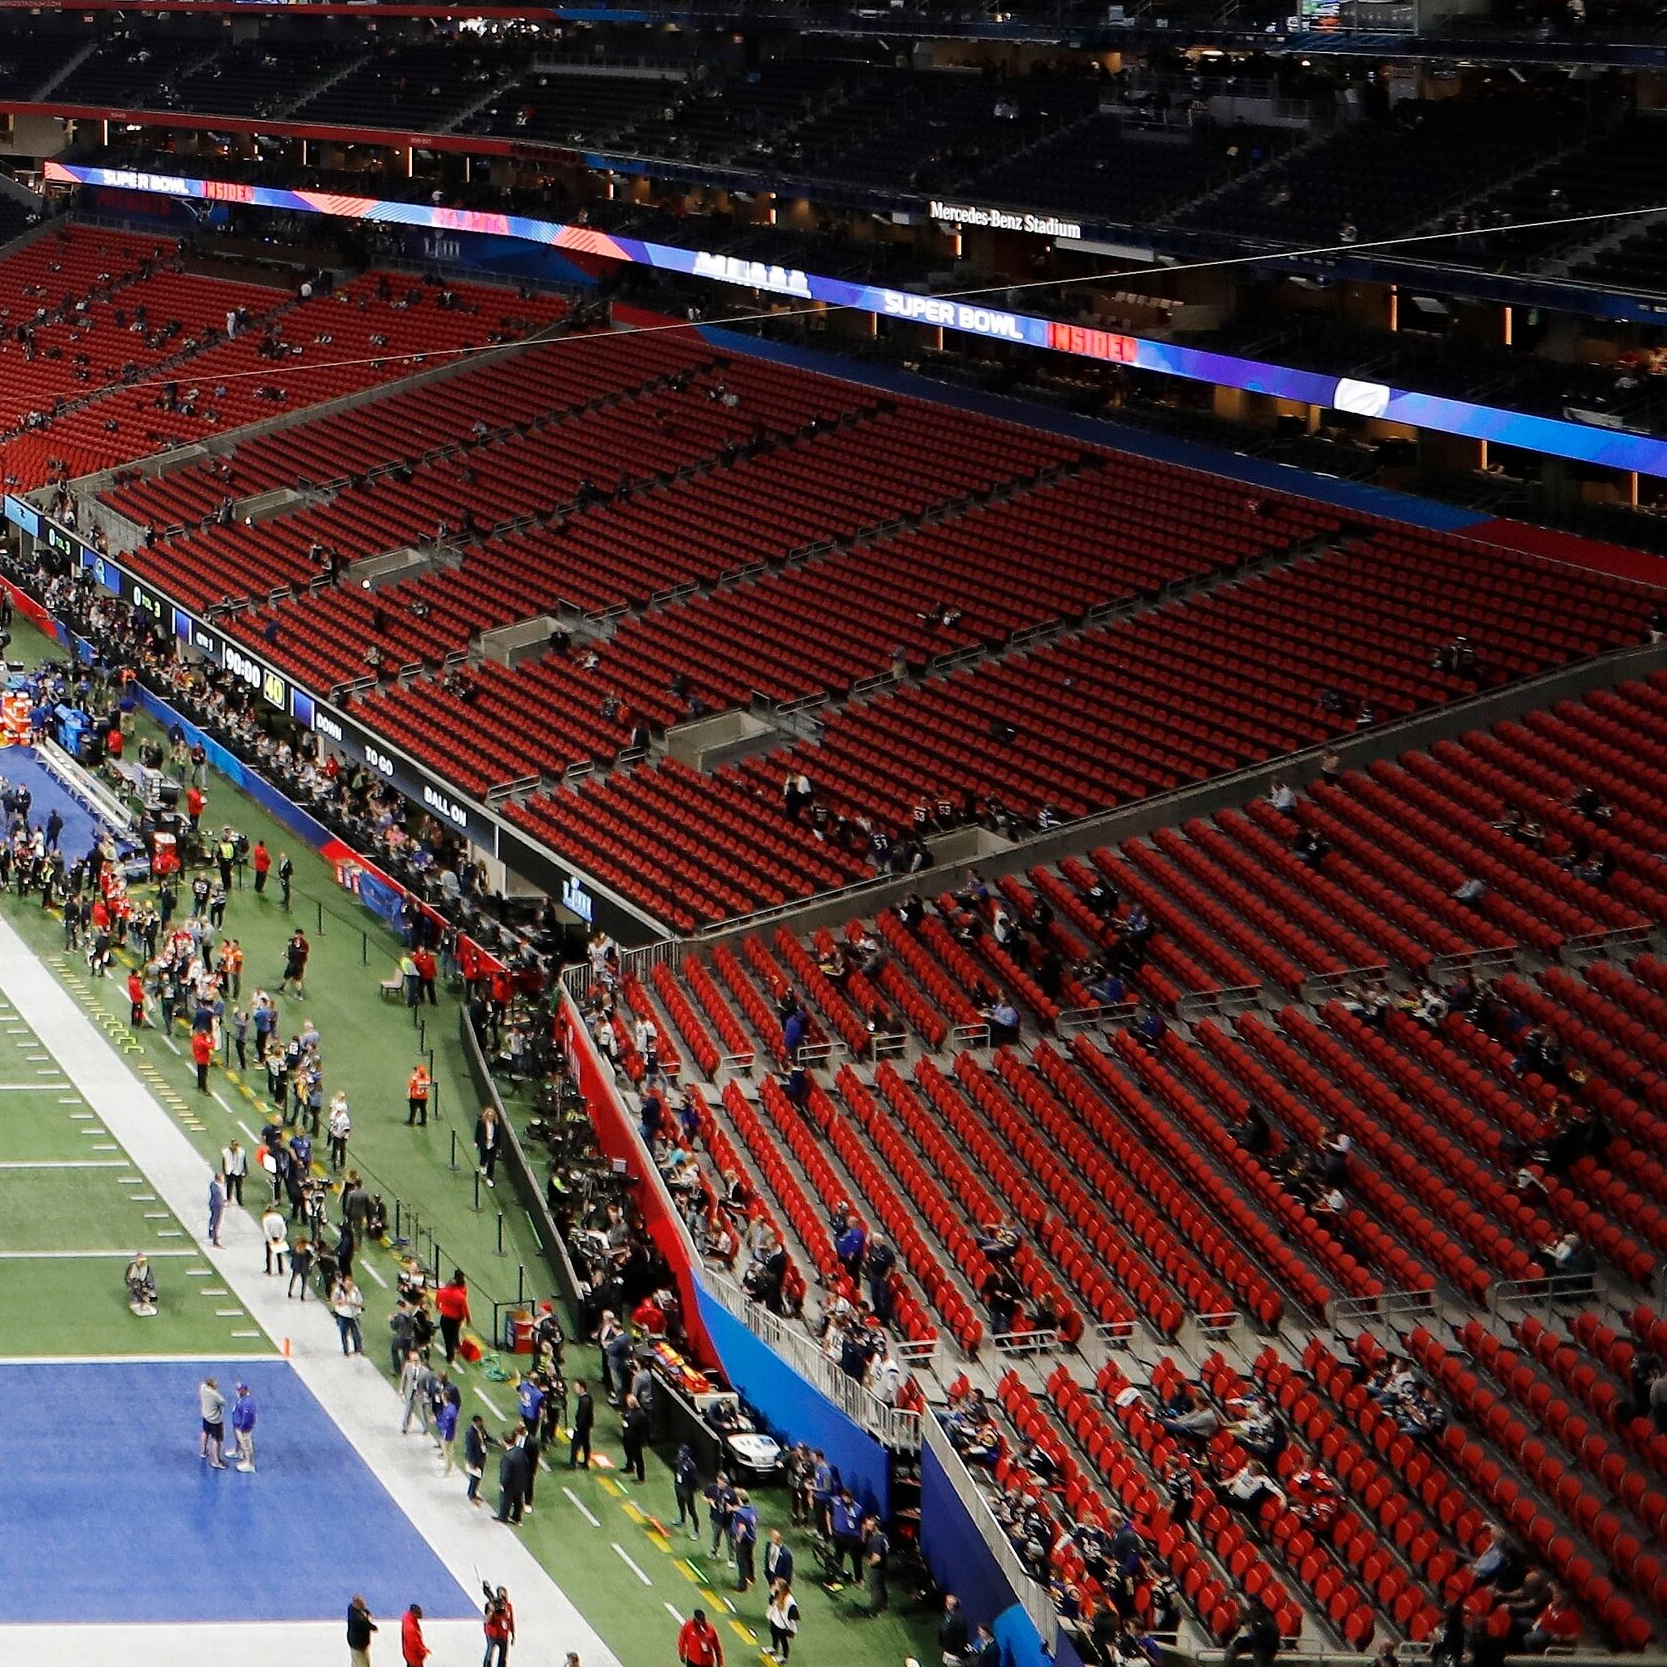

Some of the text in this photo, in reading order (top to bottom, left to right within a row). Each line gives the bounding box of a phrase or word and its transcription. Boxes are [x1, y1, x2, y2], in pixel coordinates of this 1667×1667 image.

[102, 170, 148, 190] SUPER
[150, 176, 190, 195] BOWL
[929, 200, 1082, 239] Mercedes-Benz Stadium
[885, 290, 955, 328] SUPER
[958, 306, 1024, 340] BOWL
[48, 527, 56, 547] 0
[65, 541, 72, 556] 3
[132, 585, 142, 607] 0
[153, 601, 162, 618] 3
[225, 647, 284, 705] 90:00 40
[317, 712, 467, 828] DOWN TO GO BALL ON
